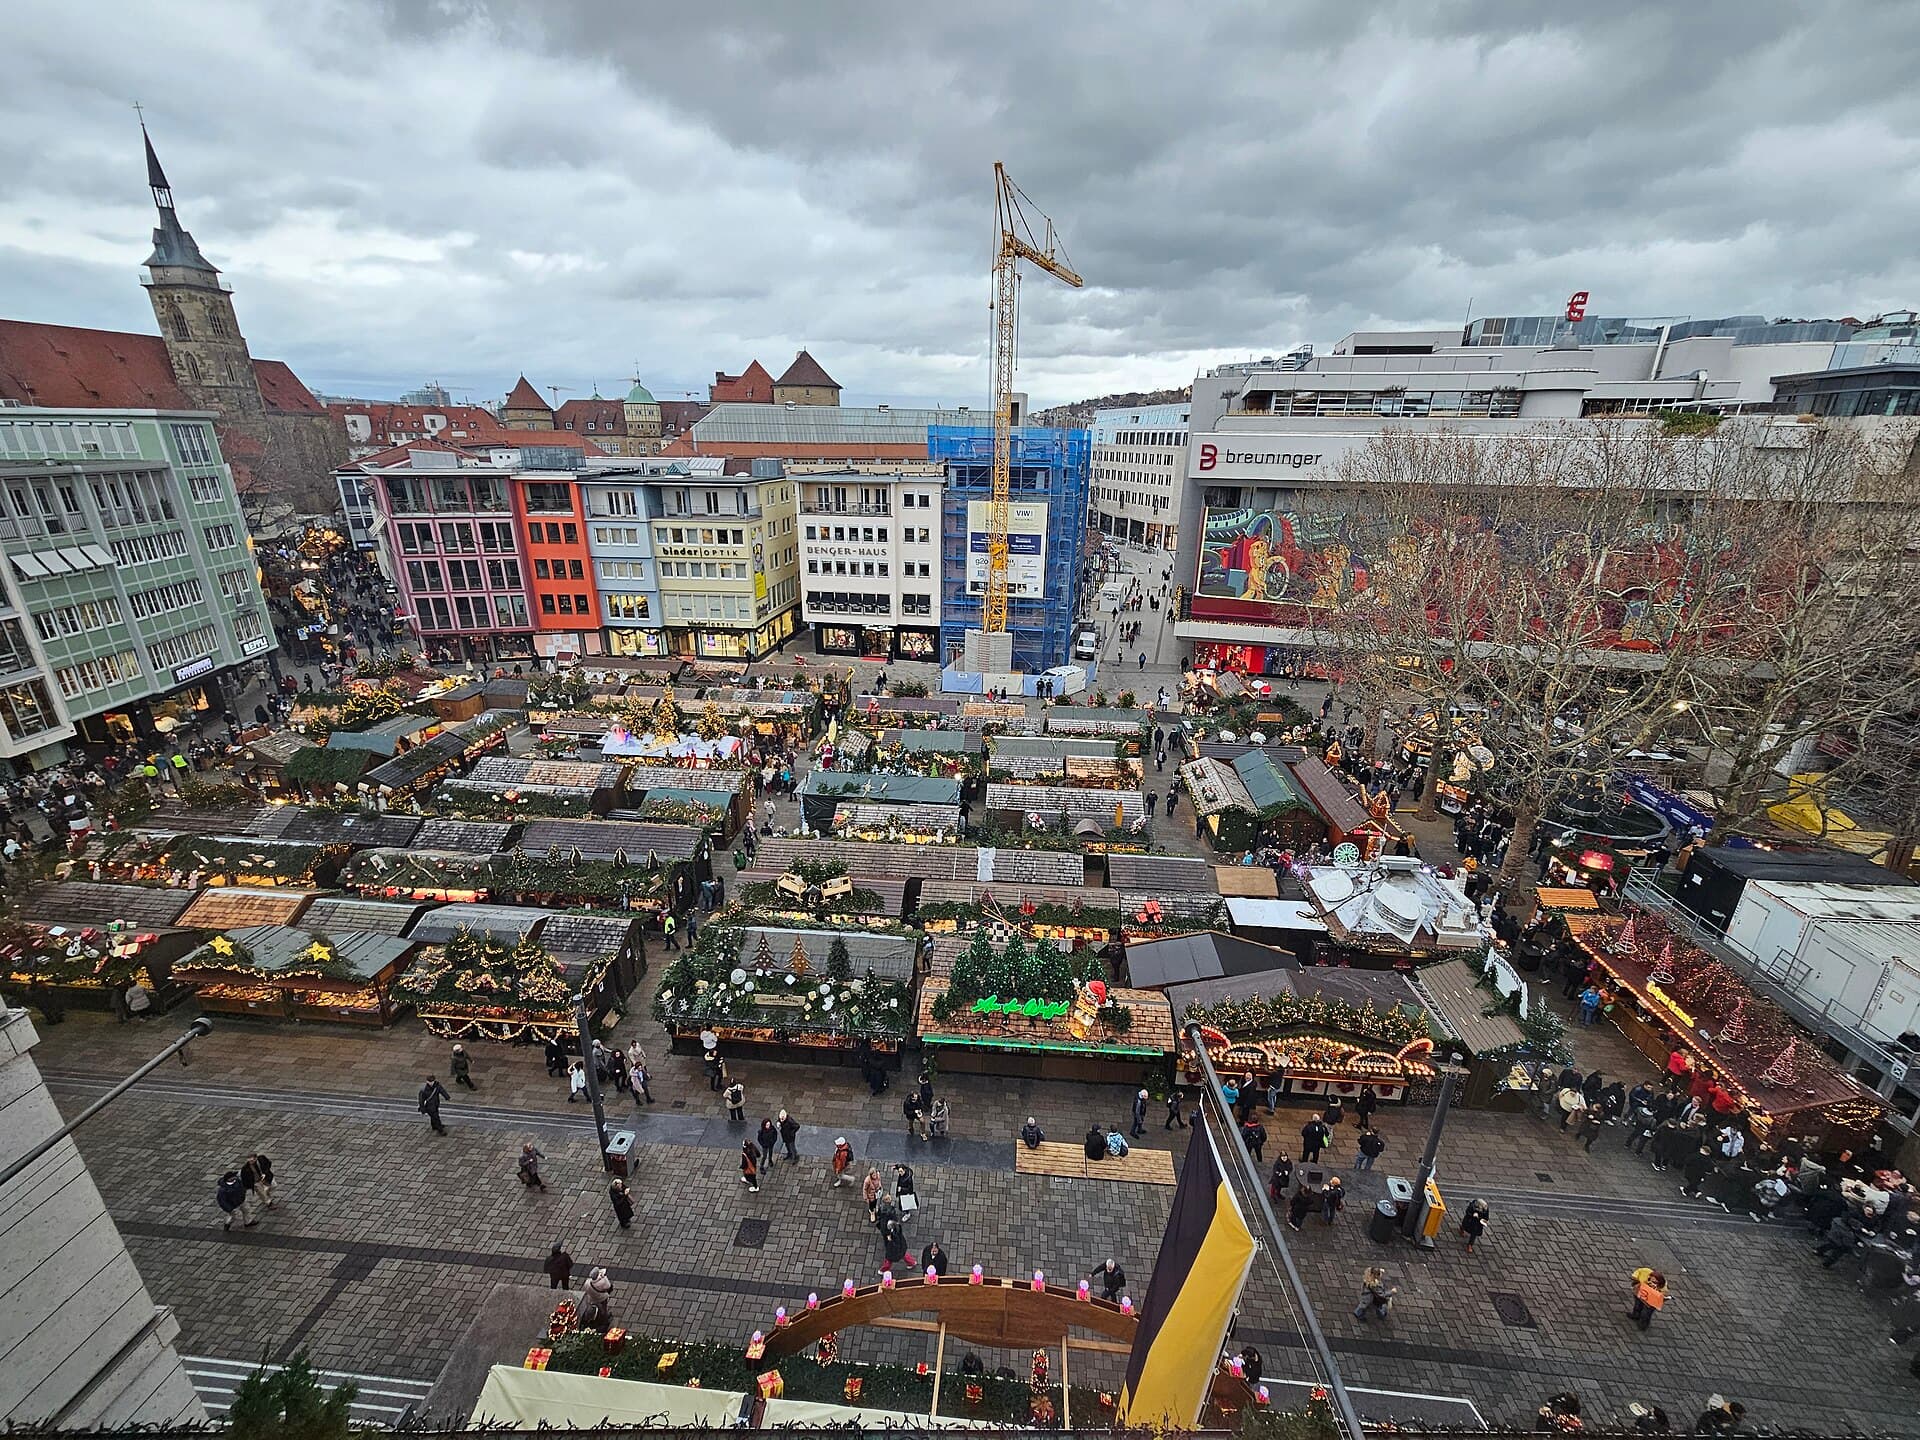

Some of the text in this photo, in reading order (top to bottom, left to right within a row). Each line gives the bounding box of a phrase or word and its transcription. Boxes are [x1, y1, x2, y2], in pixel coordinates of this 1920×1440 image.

[1226, 449, 1322, 468] breuninger
[662, 547, 698, 556] binder
[807, 546, 887, 556] BENGER-HAUS
